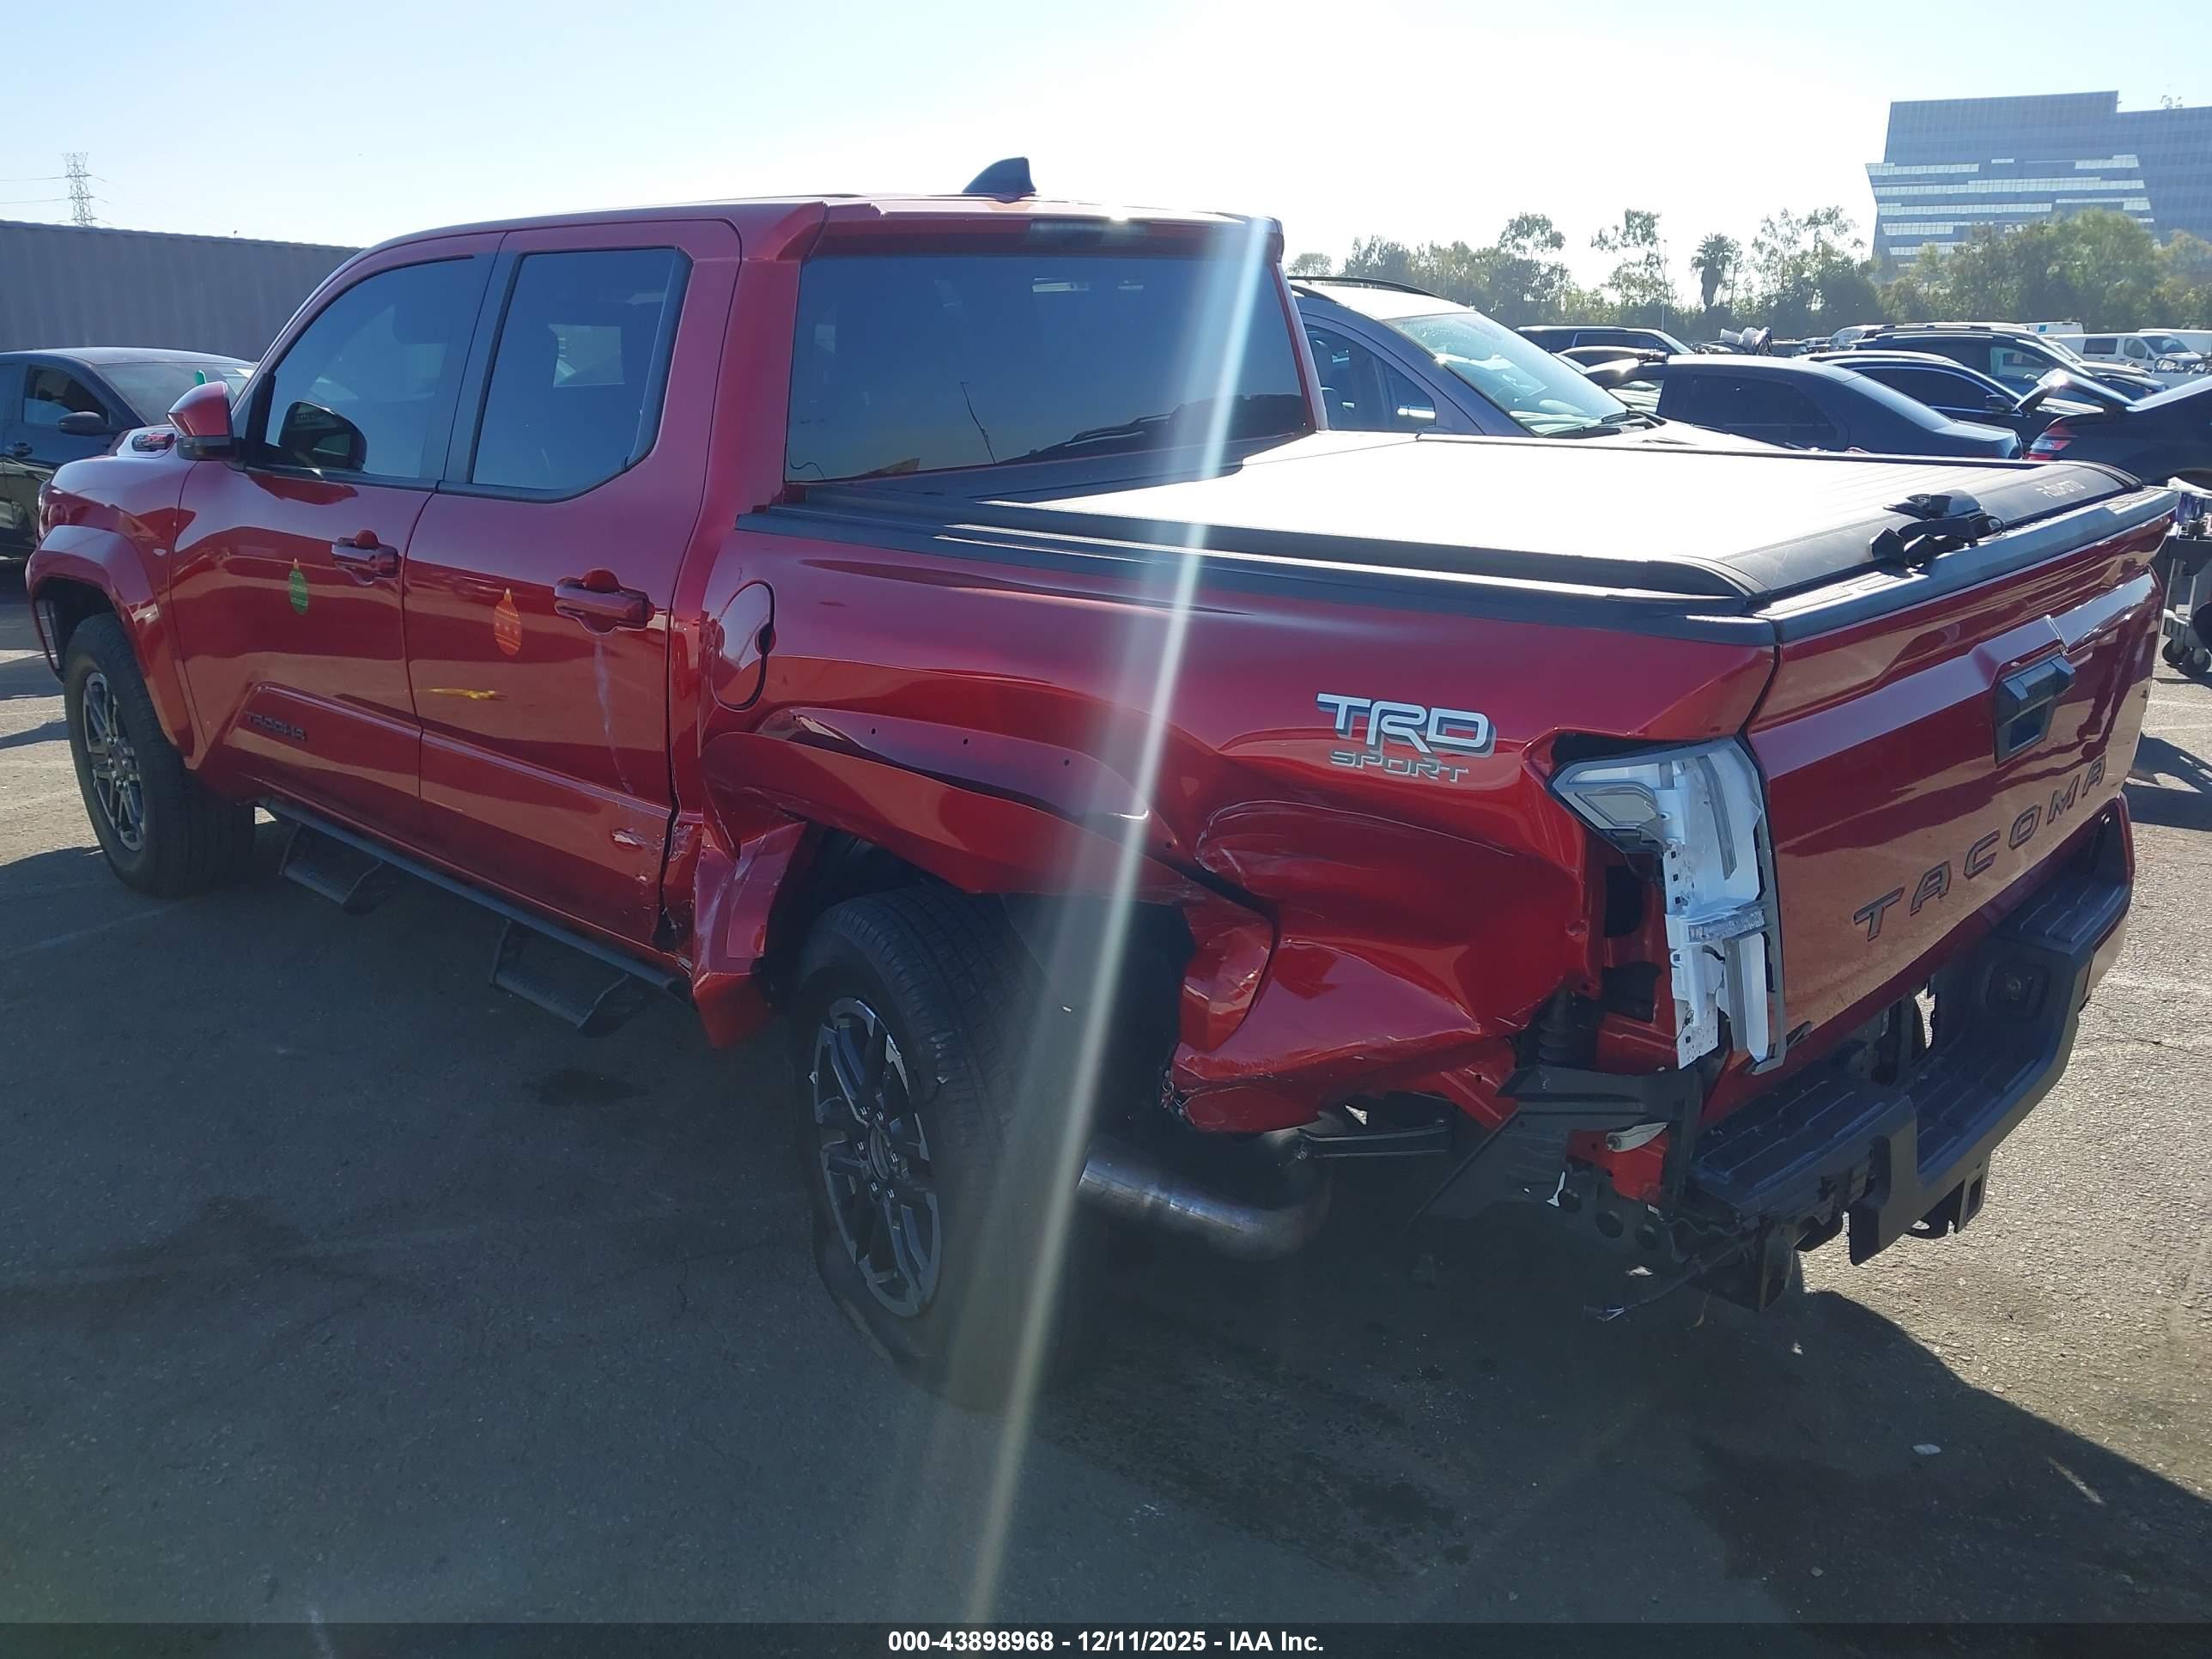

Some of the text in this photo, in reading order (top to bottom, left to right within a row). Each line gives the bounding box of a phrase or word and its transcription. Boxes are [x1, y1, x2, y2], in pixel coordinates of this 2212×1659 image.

[1316, 692, 1494, 756] TRD
[1330, 750, 1469, 783] SPORT
[1853, 755, 2106, 941] TACOMA
